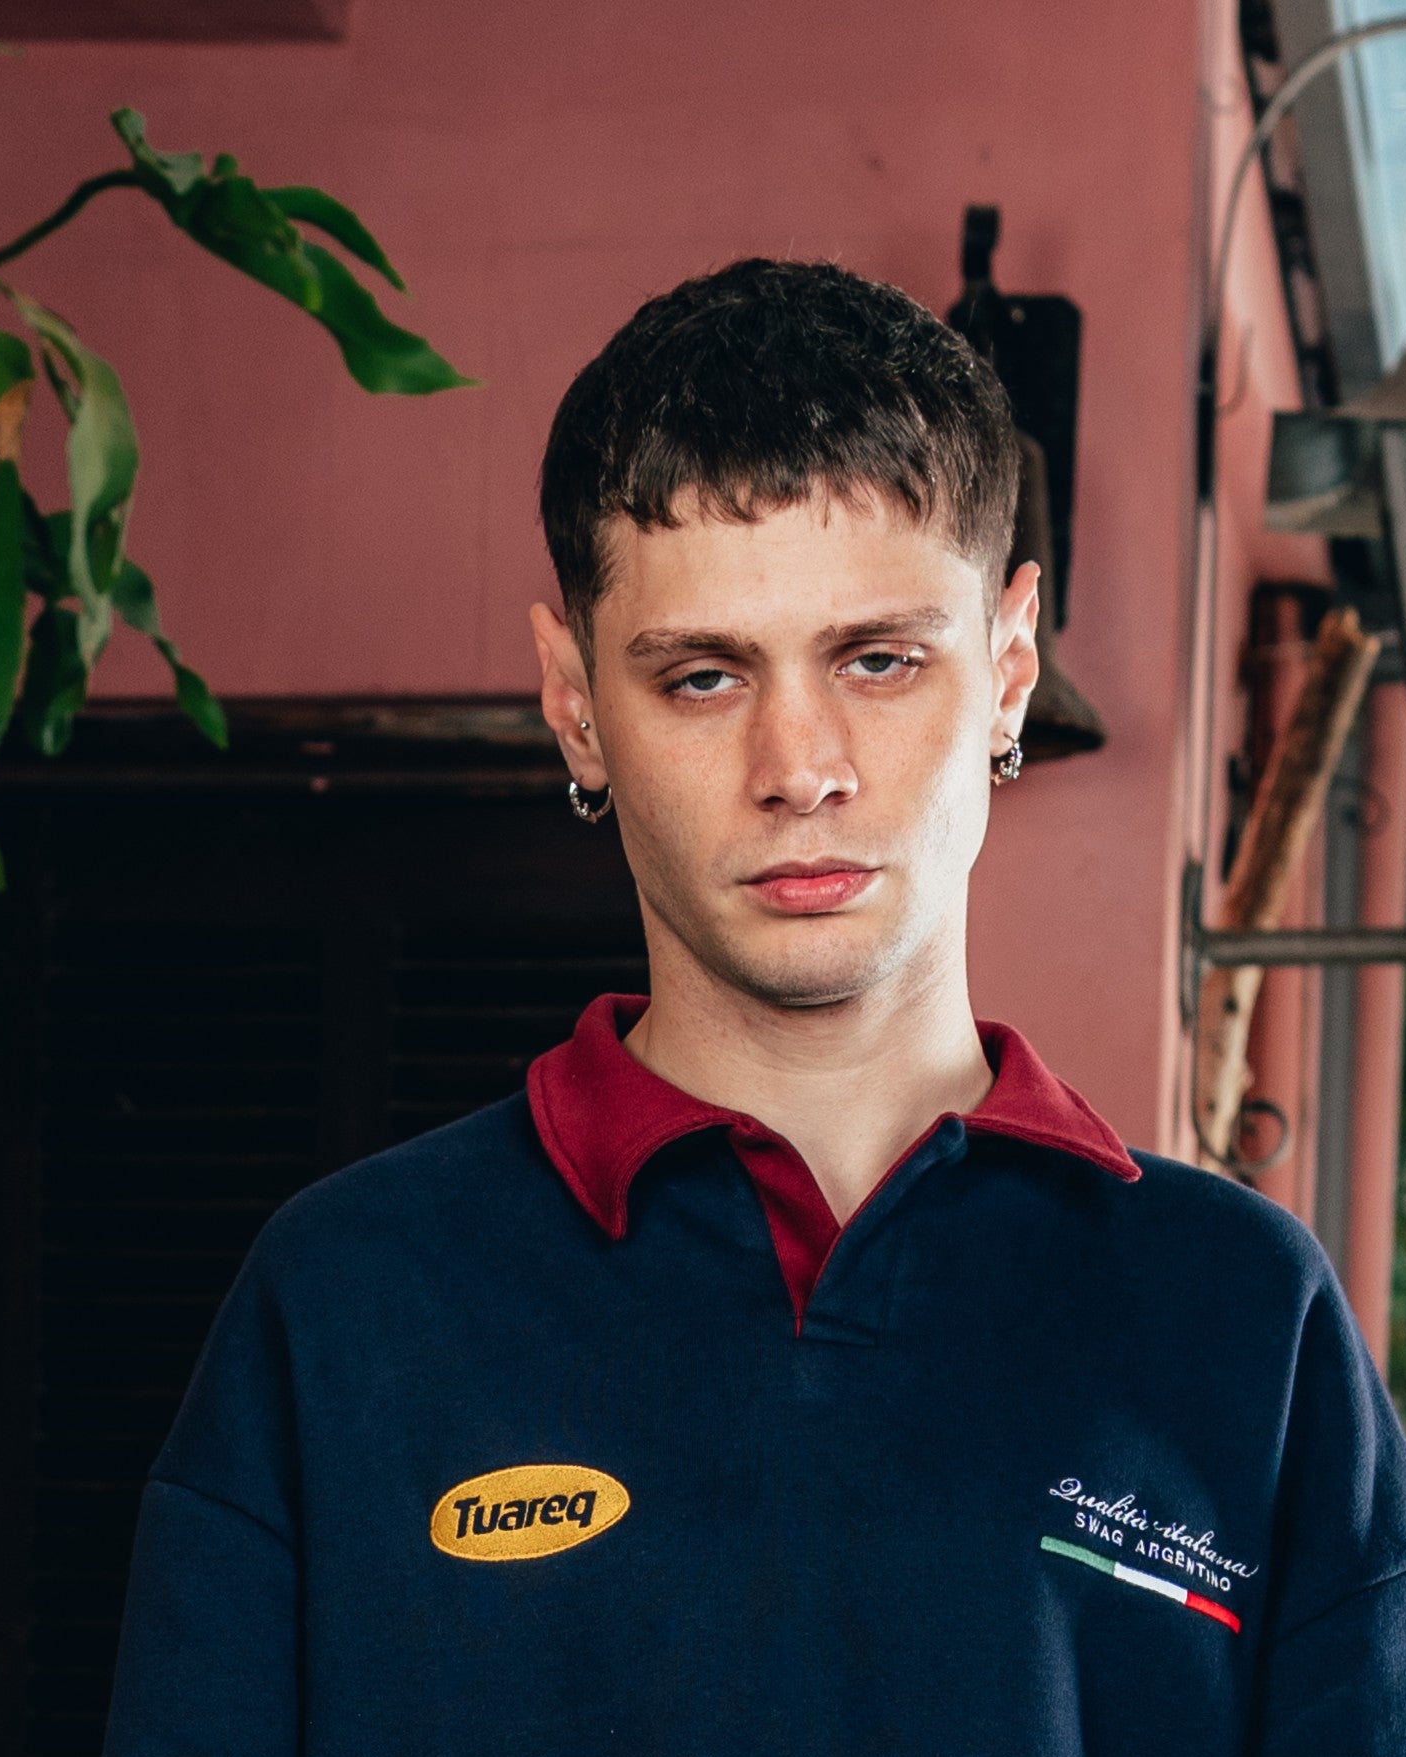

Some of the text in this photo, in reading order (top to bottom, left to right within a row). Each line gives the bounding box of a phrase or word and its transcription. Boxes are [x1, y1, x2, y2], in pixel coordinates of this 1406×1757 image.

[1074, 1511, 1232, 1592] SWAG ARGENTINO
[1153, 1521, 1260, 1578] italiana
